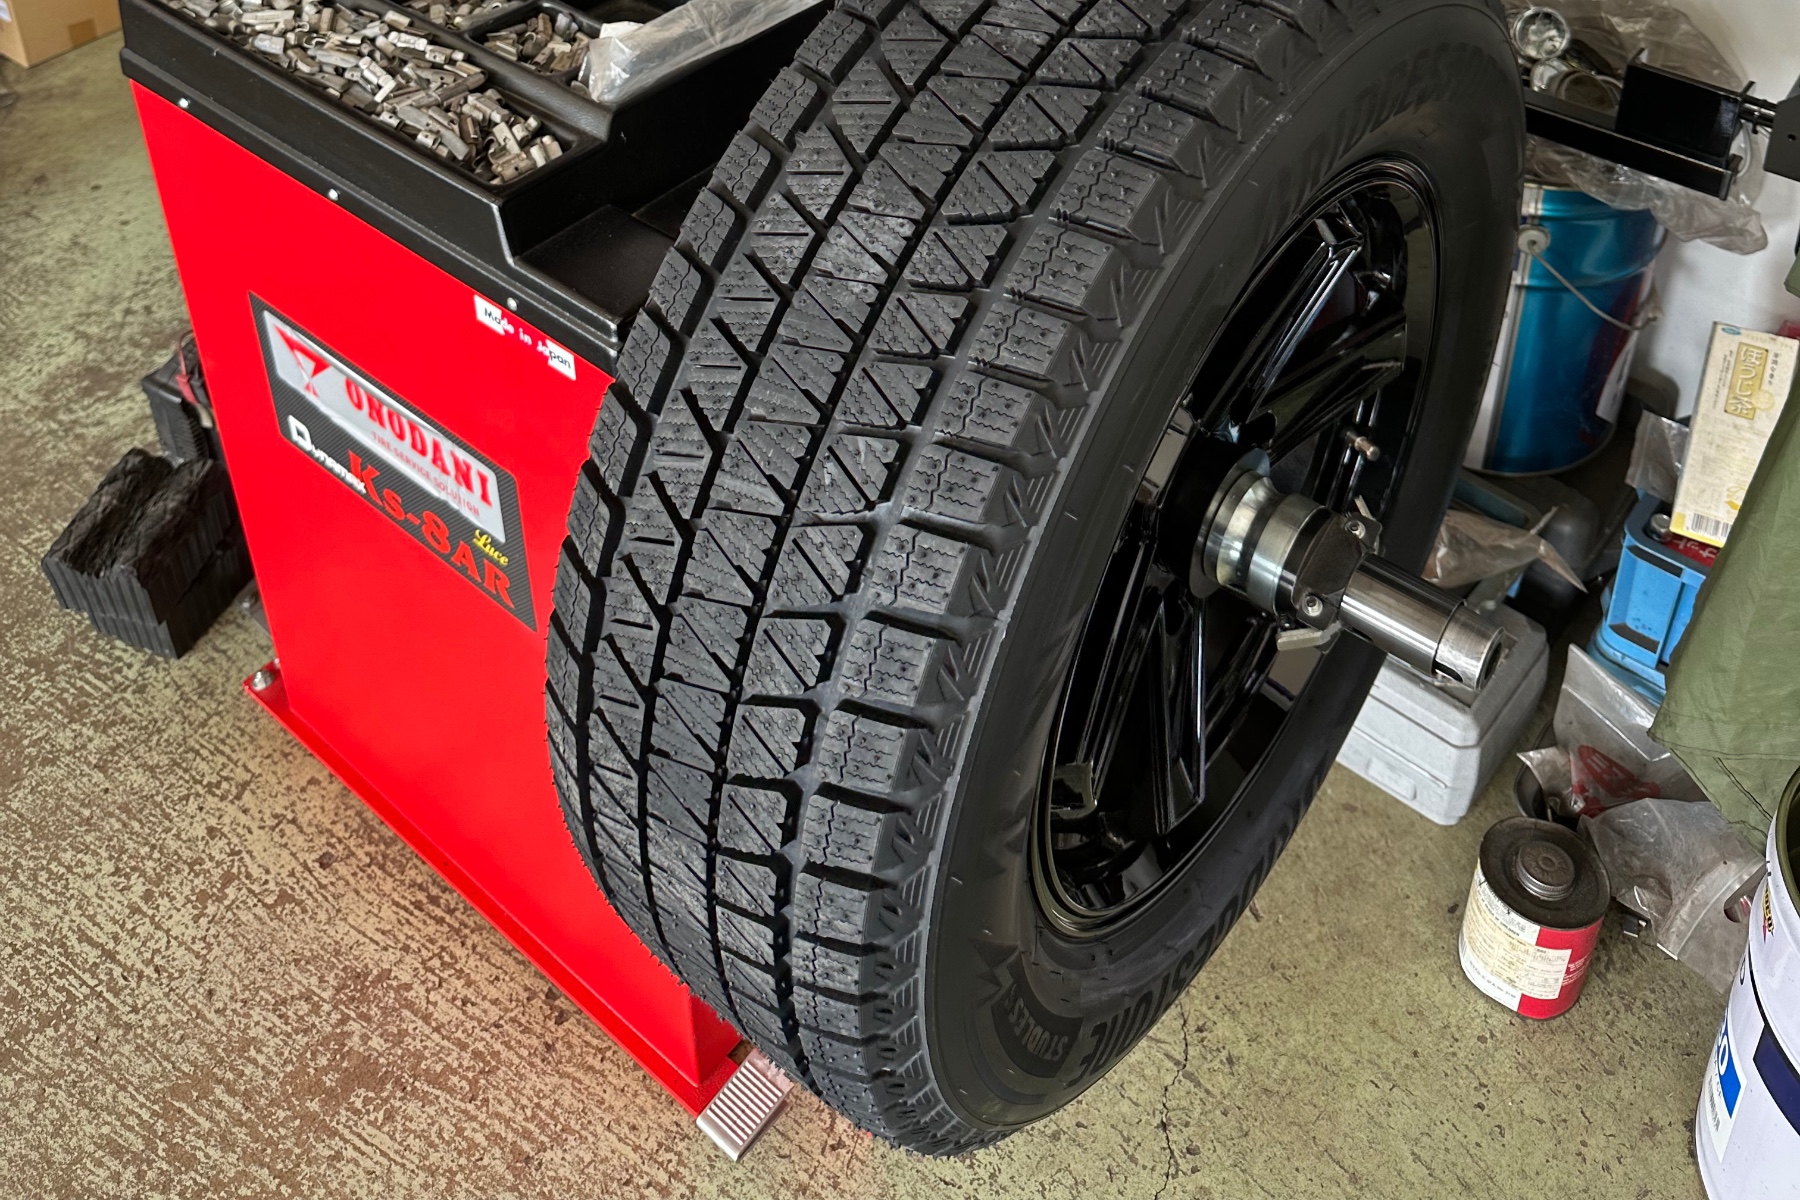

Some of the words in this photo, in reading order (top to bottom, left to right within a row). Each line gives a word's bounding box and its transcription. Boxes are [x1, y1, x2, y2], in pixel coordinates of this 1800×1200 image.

[483, 306, 515, 335] Made
[518, 326, 533, 346] in
[536, 340, 572, 370] Japan
[1728, 346, 1763, 416] ほうじ茶
[344, 375, 493, 508] ONODANI
[371, 430, 393, 452] TIRE
[393, 447, 432, 480] SERVICE
[433, 476, 481, 517] SOLUTION
